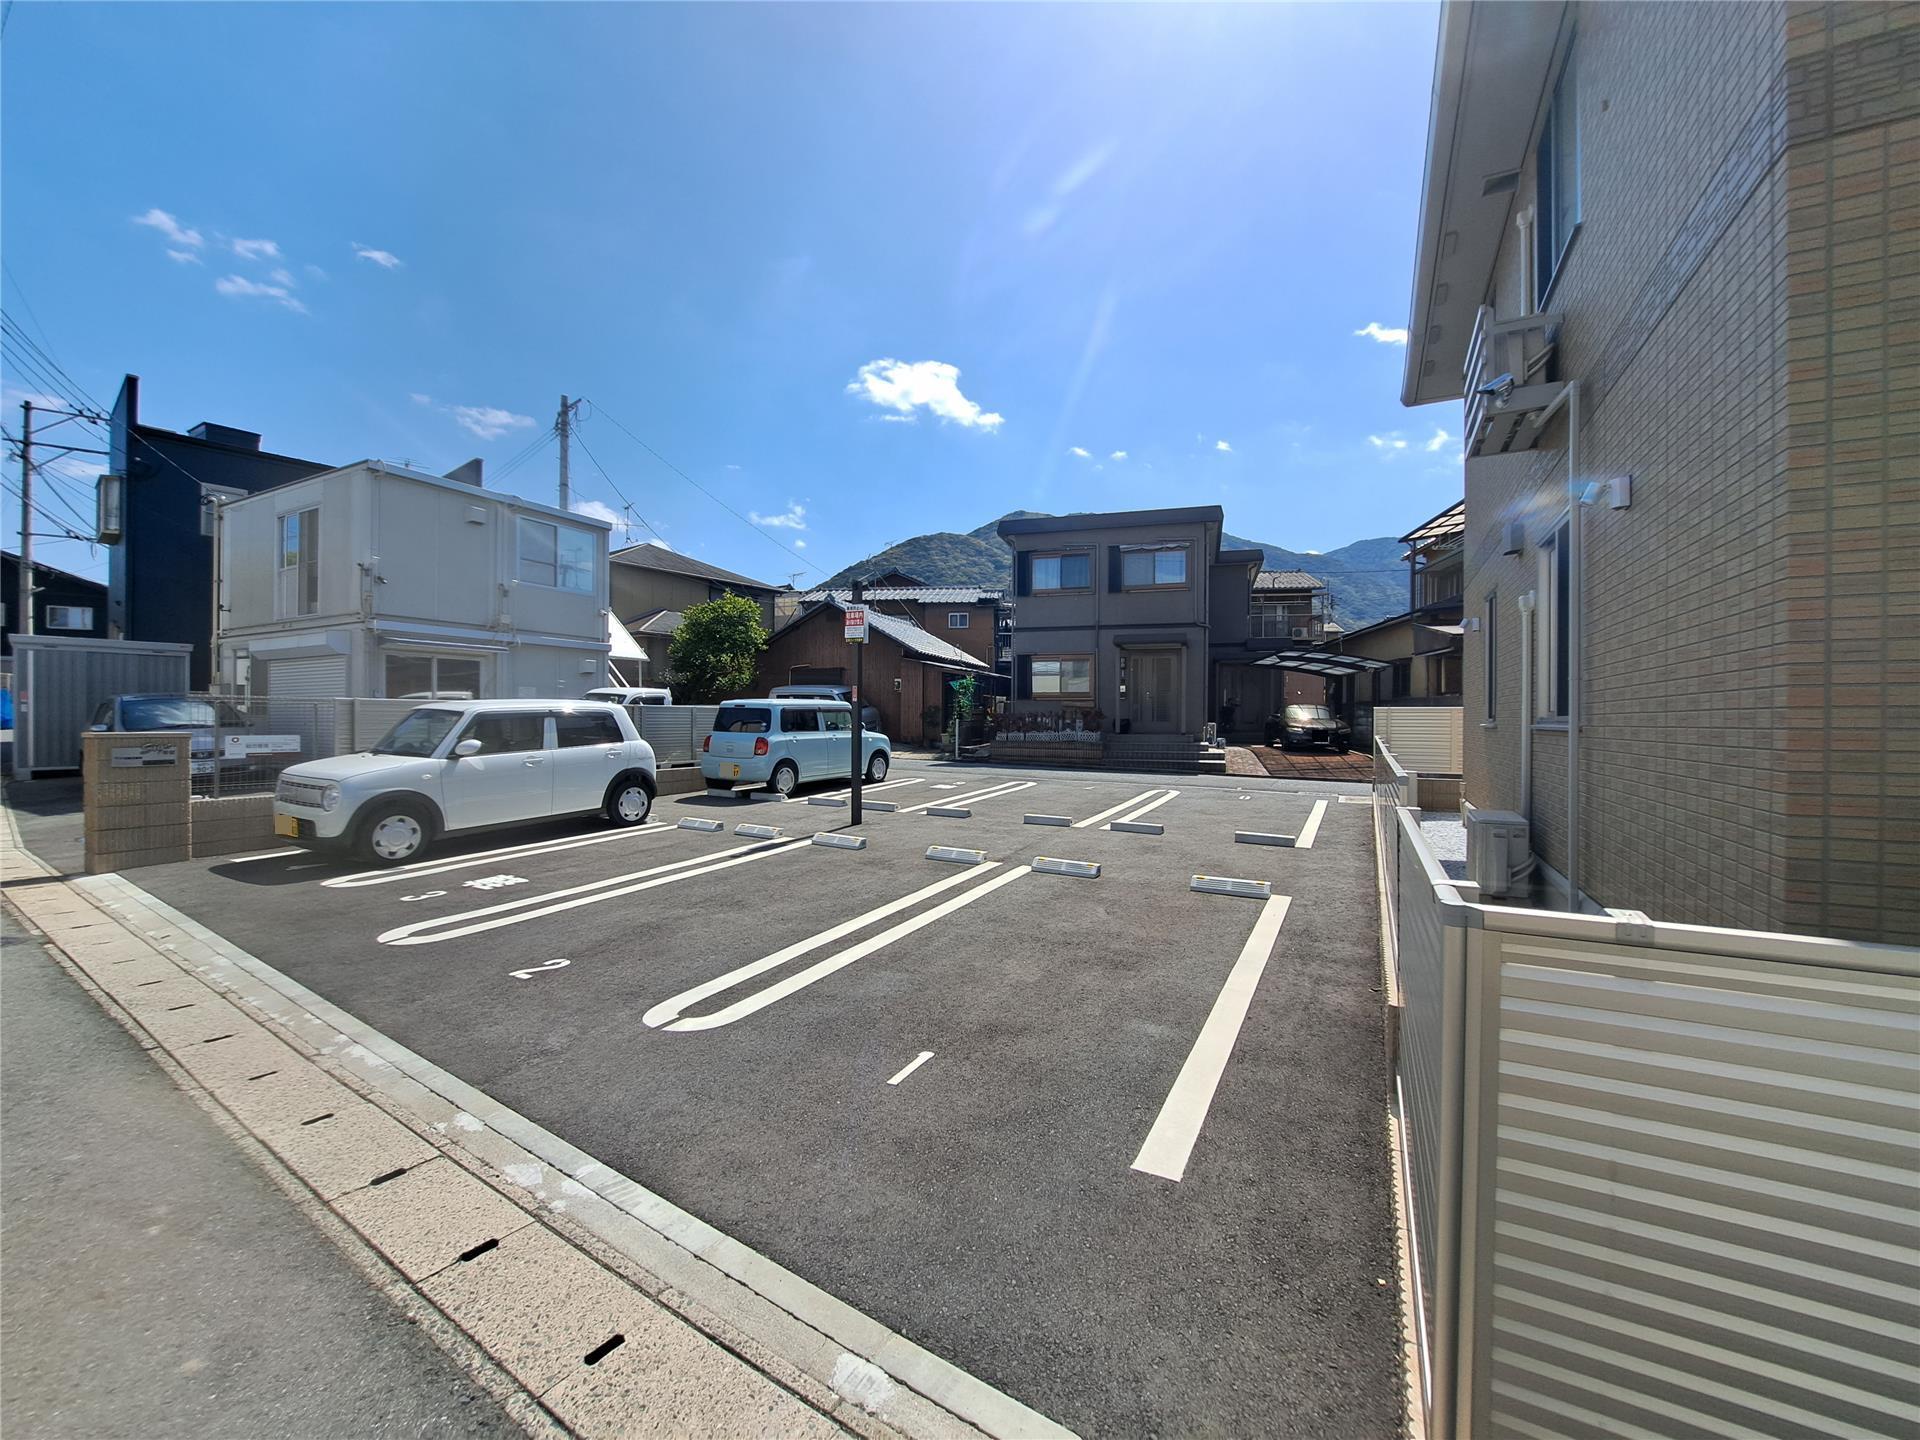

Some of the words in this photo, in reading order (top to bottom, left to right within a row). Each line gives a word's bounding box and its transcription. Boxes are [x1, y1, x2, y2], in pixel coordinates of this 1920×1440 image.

[400, 890, 448, 902] 3
[508, 958, 571, 980] 2
[886, 1050, 935, 1086] 1
